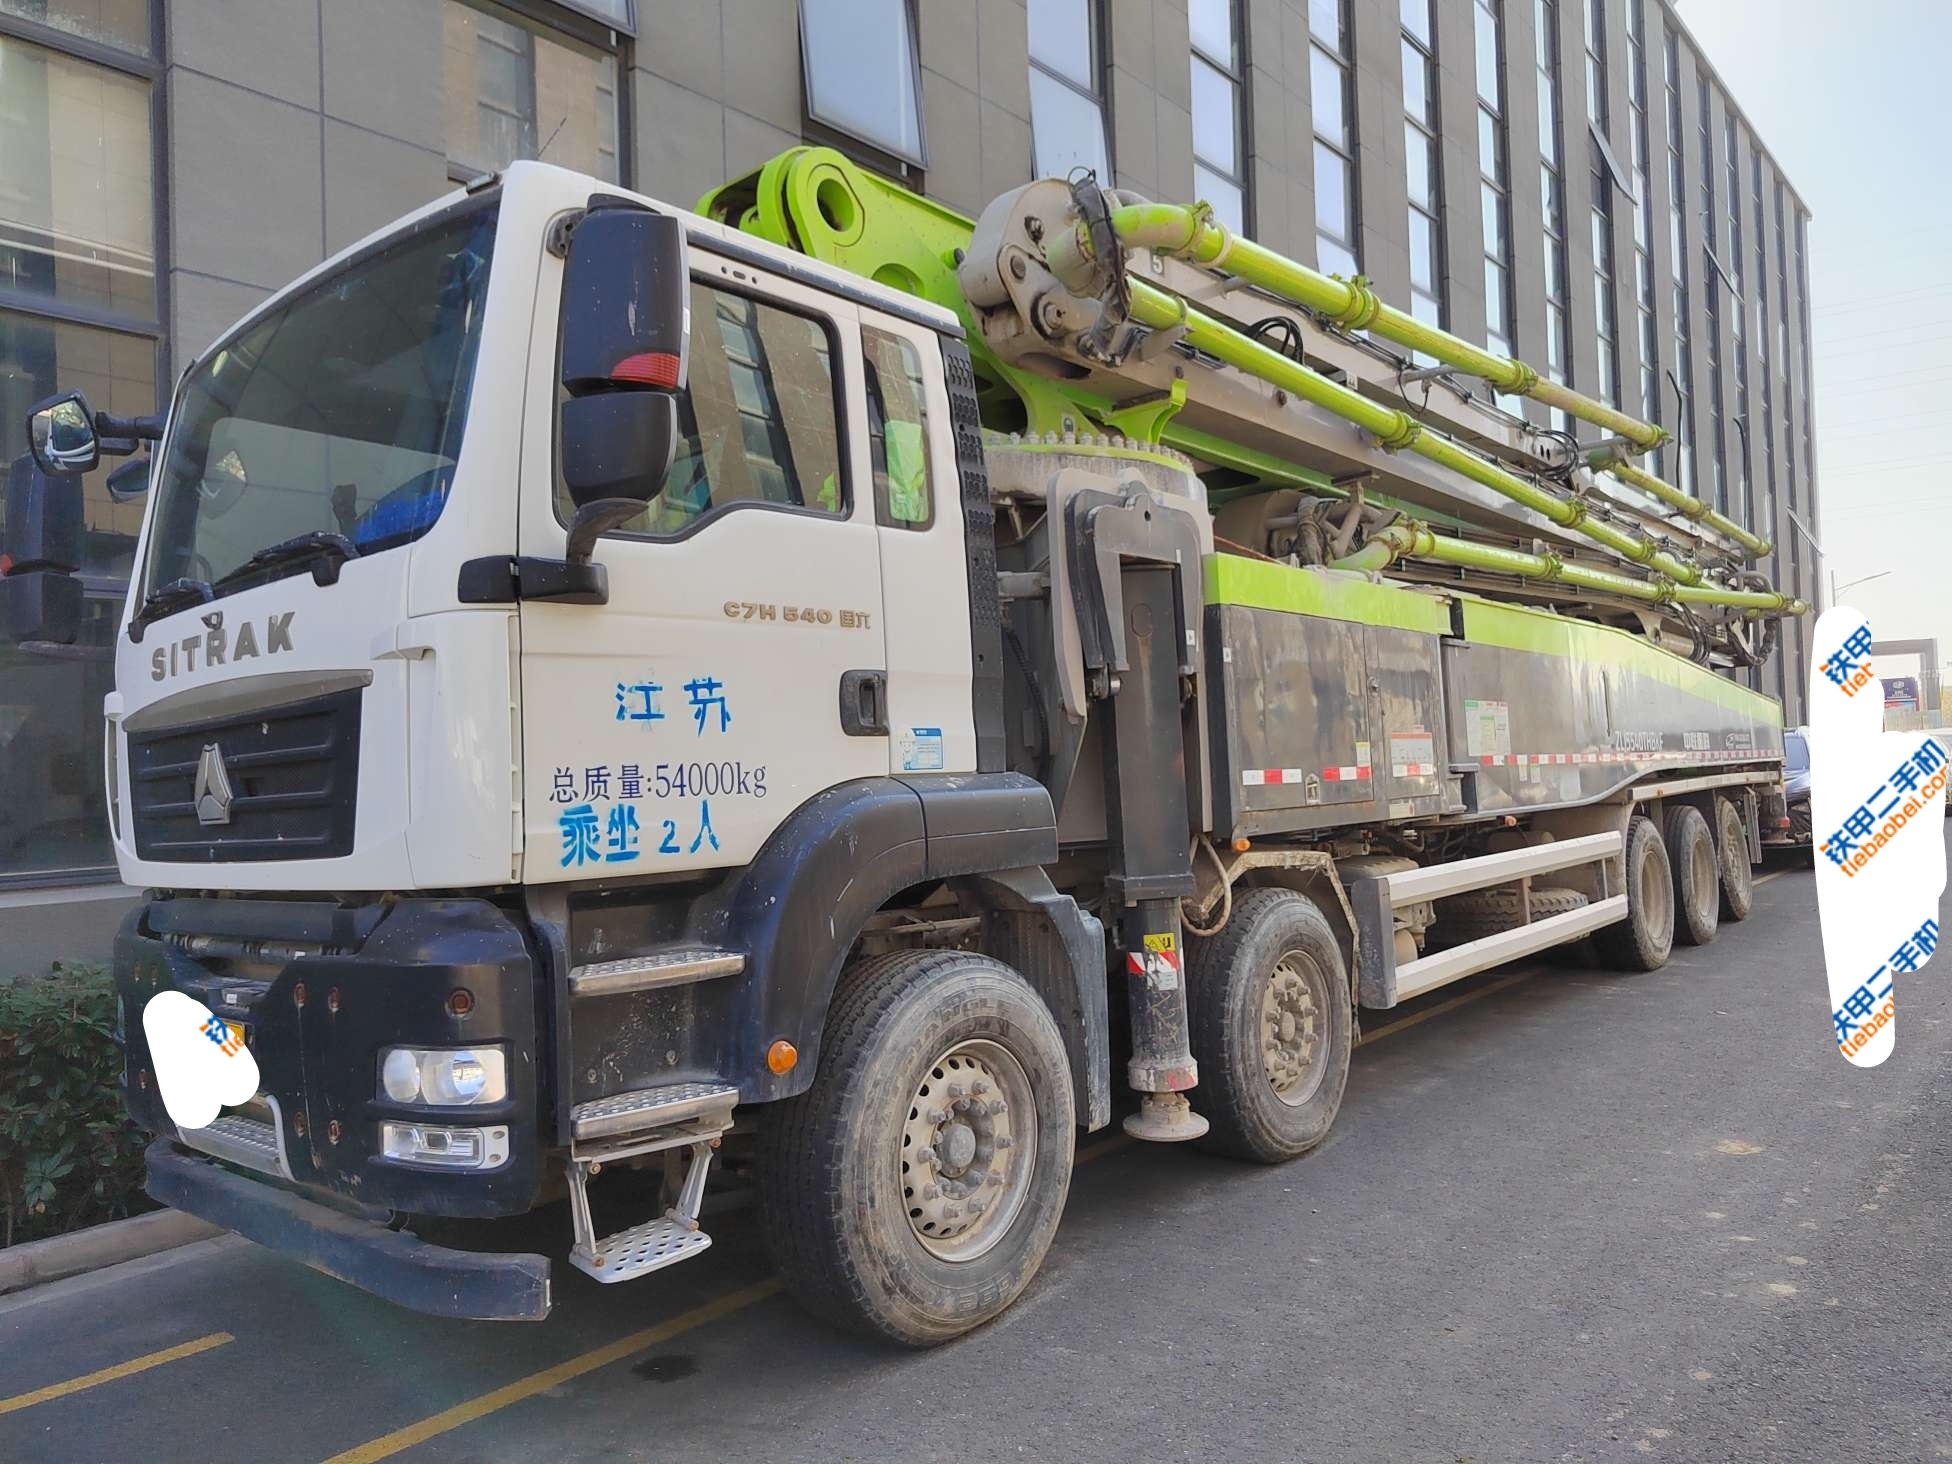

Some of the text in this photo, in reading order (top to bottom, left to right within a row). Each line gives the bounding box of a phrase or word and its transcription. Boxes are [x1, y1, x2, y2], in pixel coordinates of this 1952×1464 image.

[723, 600, 777, 621] C7H
[783, 605, 833, 625] 540
[151, 611, 295, 682] SITRAK
[615, 676, 732, 737] 江苏
